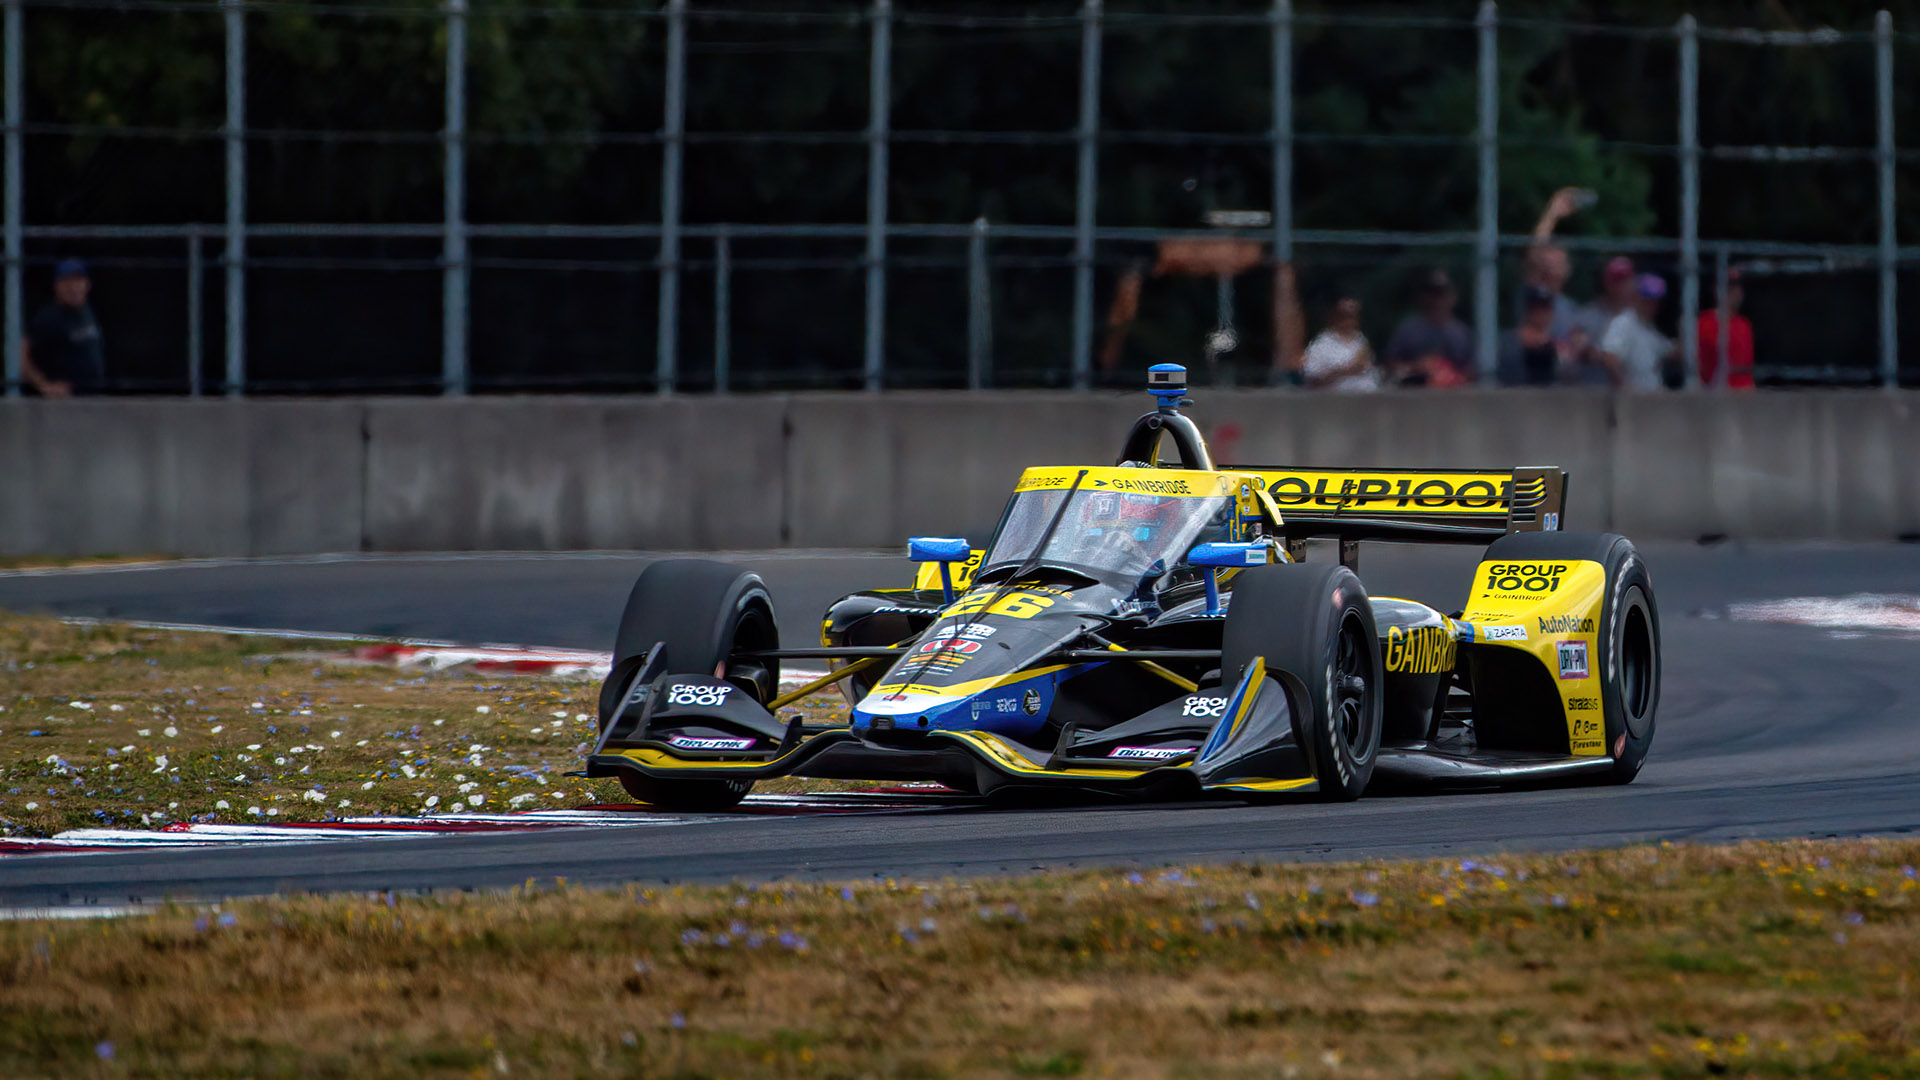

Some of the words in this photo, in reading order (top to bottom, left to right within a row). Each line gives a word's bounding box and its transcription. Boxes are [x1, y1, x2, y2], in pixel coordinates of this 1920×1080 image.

[1112, 478, 1192, 494] GAINBRIDGE
[1490, 564, 1567, 576] GROUP
[1487, 576, 1560, 592] 1001
[940, 591, 1055, 619] 26
[1538, 614, 1595, 634] AutoNation
[1493, 628, 1527, 638] ZAPATA
[671, 683, 733, 695] GROUP
[668, 692, 727, 706] 1001
[1182, 705, 1225, 717] 100
